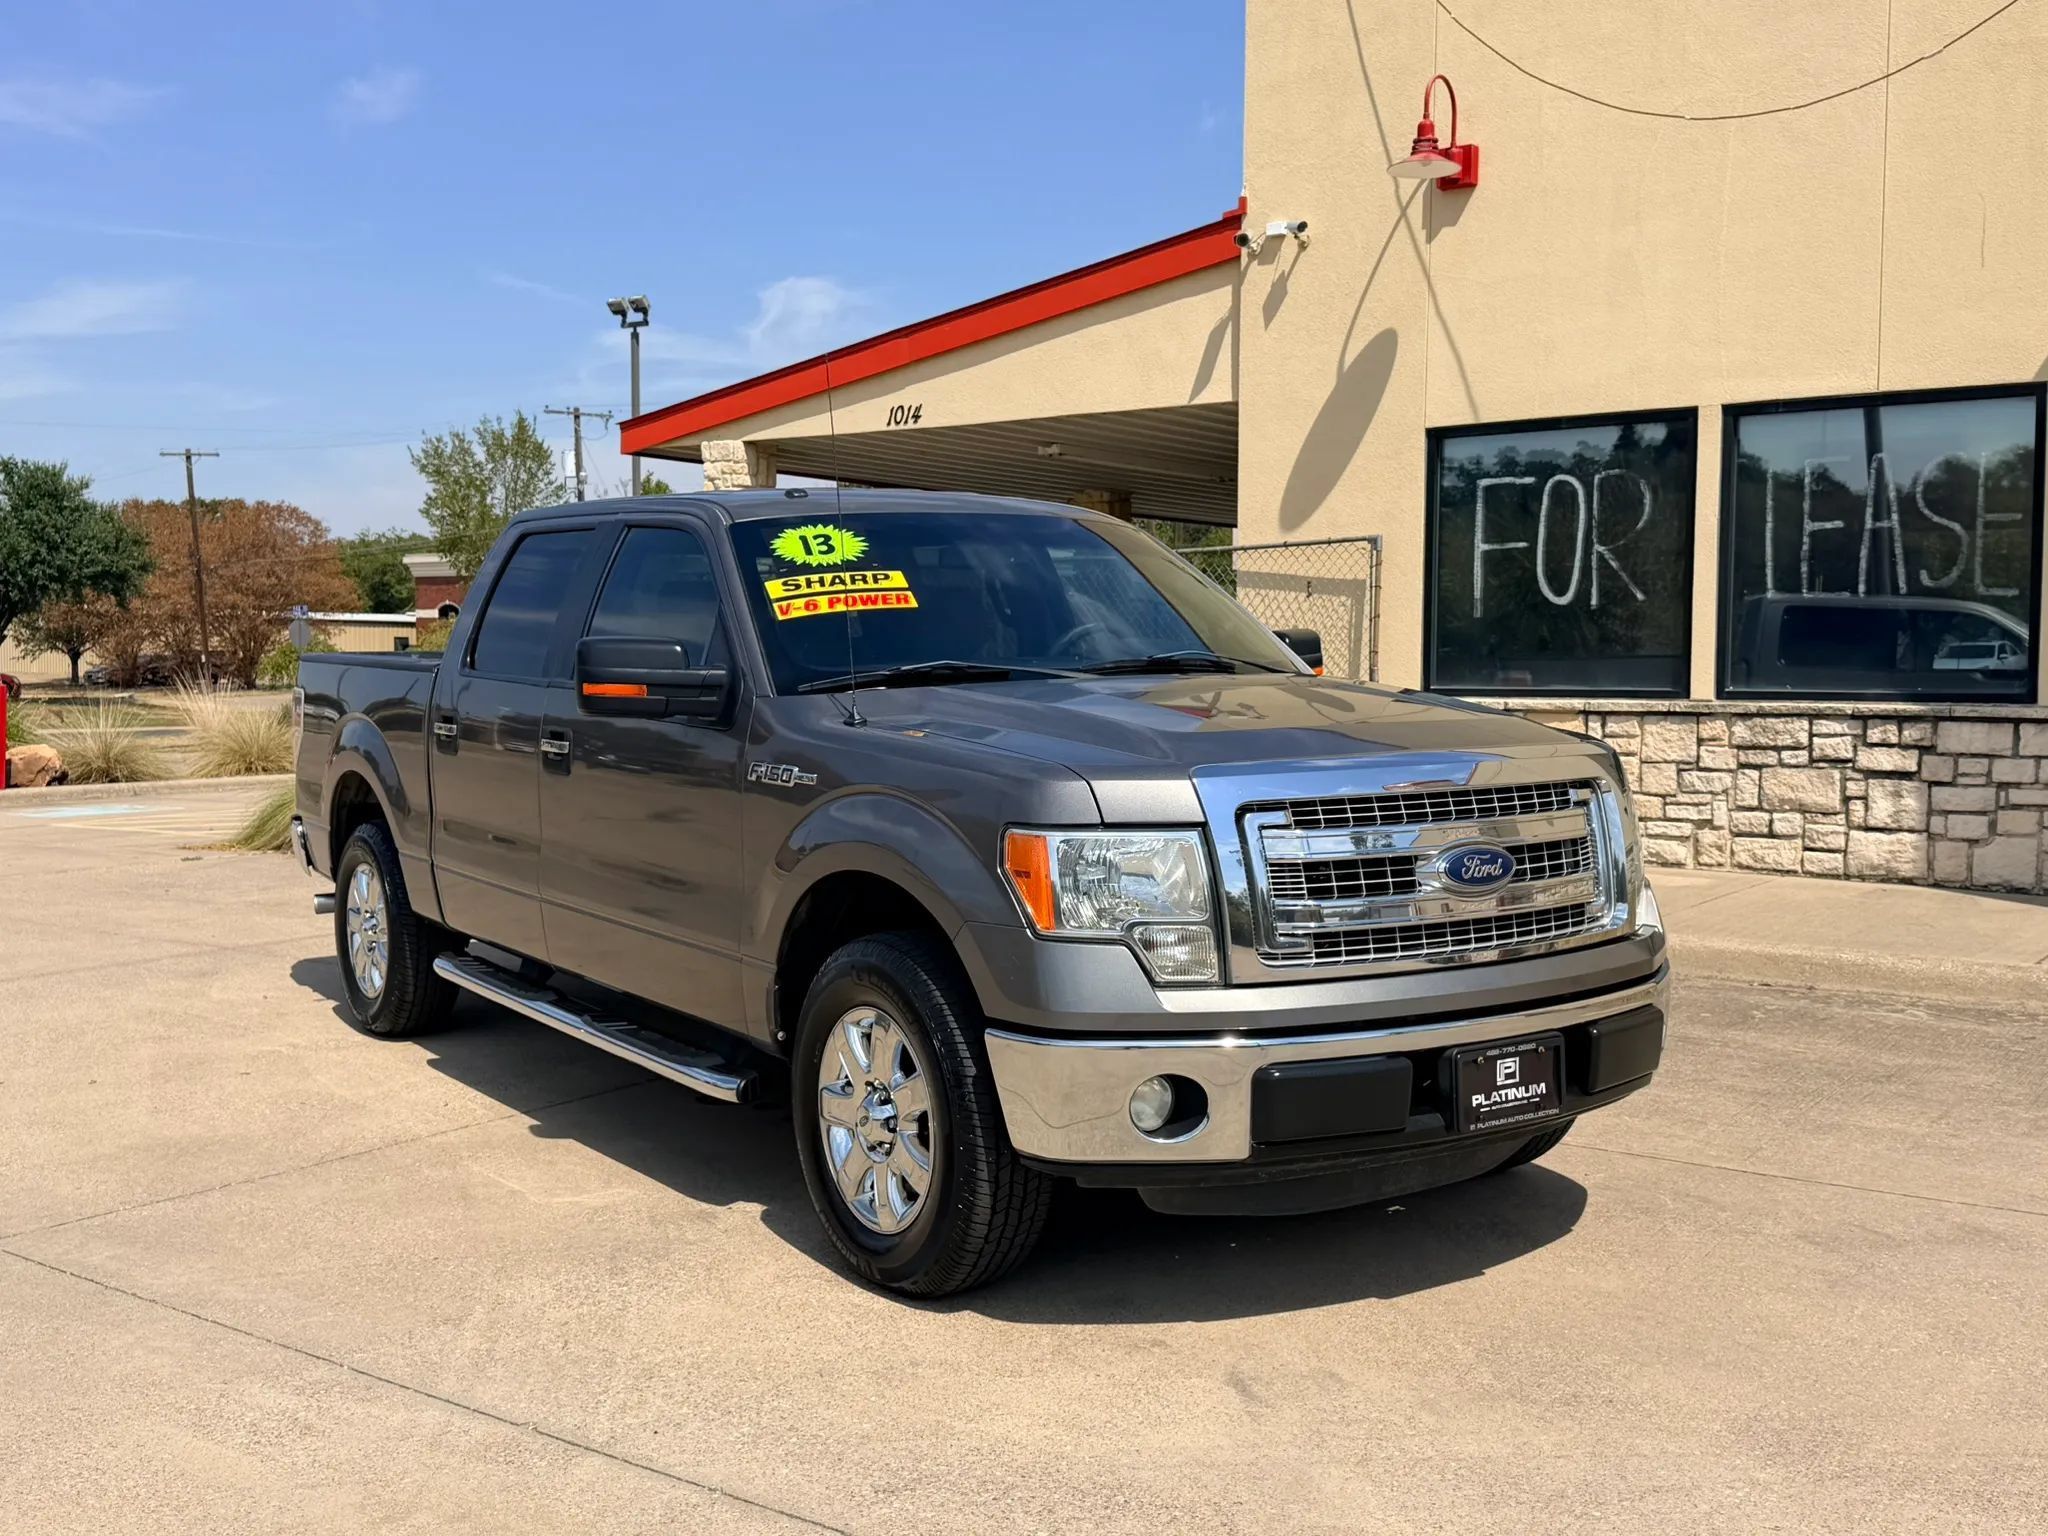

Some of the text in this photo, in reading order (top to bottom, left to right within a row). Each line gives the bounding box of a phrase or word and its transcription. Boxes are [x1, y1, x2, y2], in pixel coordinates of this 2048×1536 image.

[886, 403, 923, 428] 1014
[798, 533, 836, 557] 13
[1472, 468, 1650, 617] FOR
[780, 572, 891, 593] SHARP
[777, 592, 910, 617] V-6 POWER
[1461, 854, 1503, 879] Ford
[1471, 1082, 1547, 1107] PLATINUM
[1477, 1108, 1560, 1129] PLATINUM AUTO COLLECTION
